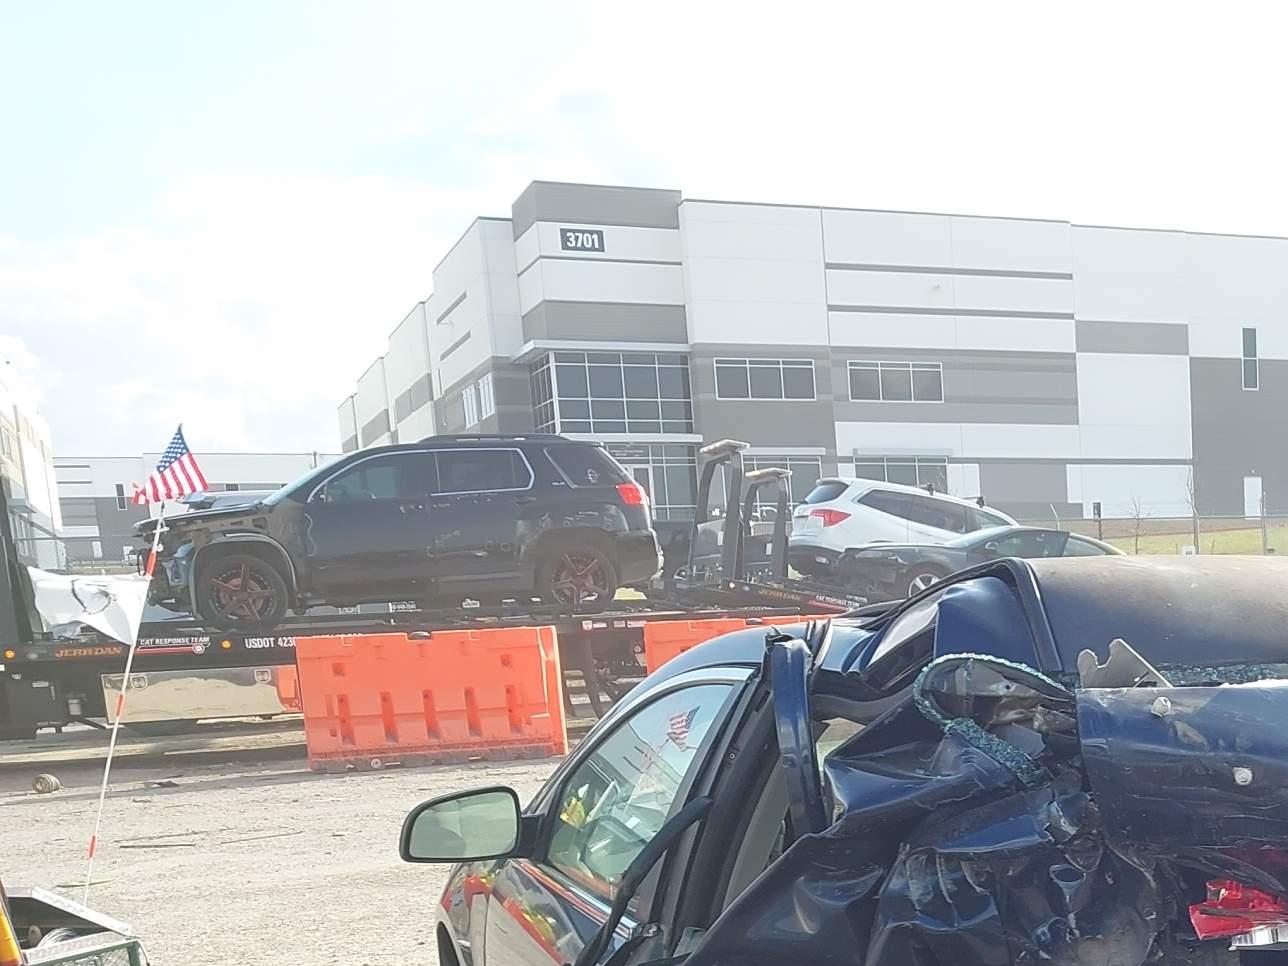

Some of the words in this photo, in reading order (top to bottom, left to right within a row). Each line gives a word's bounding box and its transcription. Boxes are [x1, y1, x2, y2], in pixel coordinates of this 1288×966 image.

[566, 232, 599, 249] 3701
[140, 638, 153, 646] CAT
[154, 637, 190, 645] RESPONSE
[244, 637, 275, 649] USDOT
